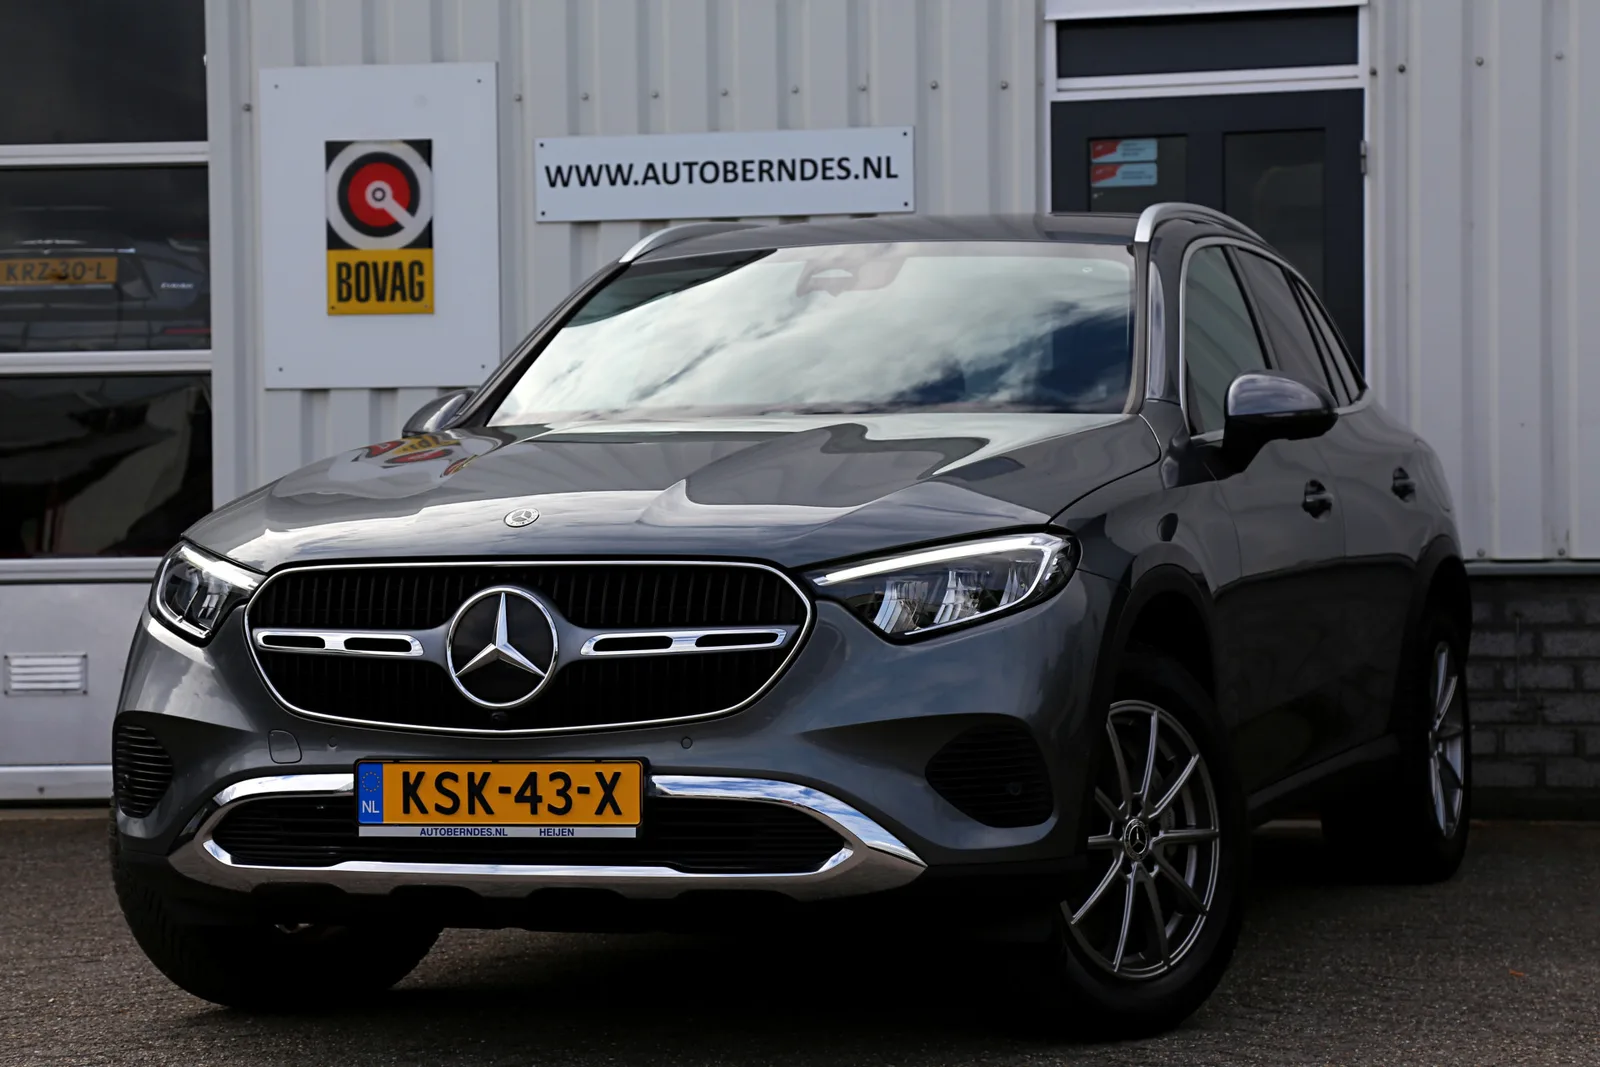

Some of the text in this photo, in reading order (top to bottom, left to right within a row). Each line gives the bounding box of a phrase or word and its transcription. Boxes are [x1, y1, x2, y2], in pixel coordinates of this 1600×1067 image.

[545, 156, 899, 188] WWW.AUTOBERNDES.NL
[336, 260, 425, 303] BOVAG
[361, 800, 380, 814] NL
[402, 771, 623, 816] KSK-43-X
[419, 827, 575, 837] AUTOBERNDES.NL HEIJEN
